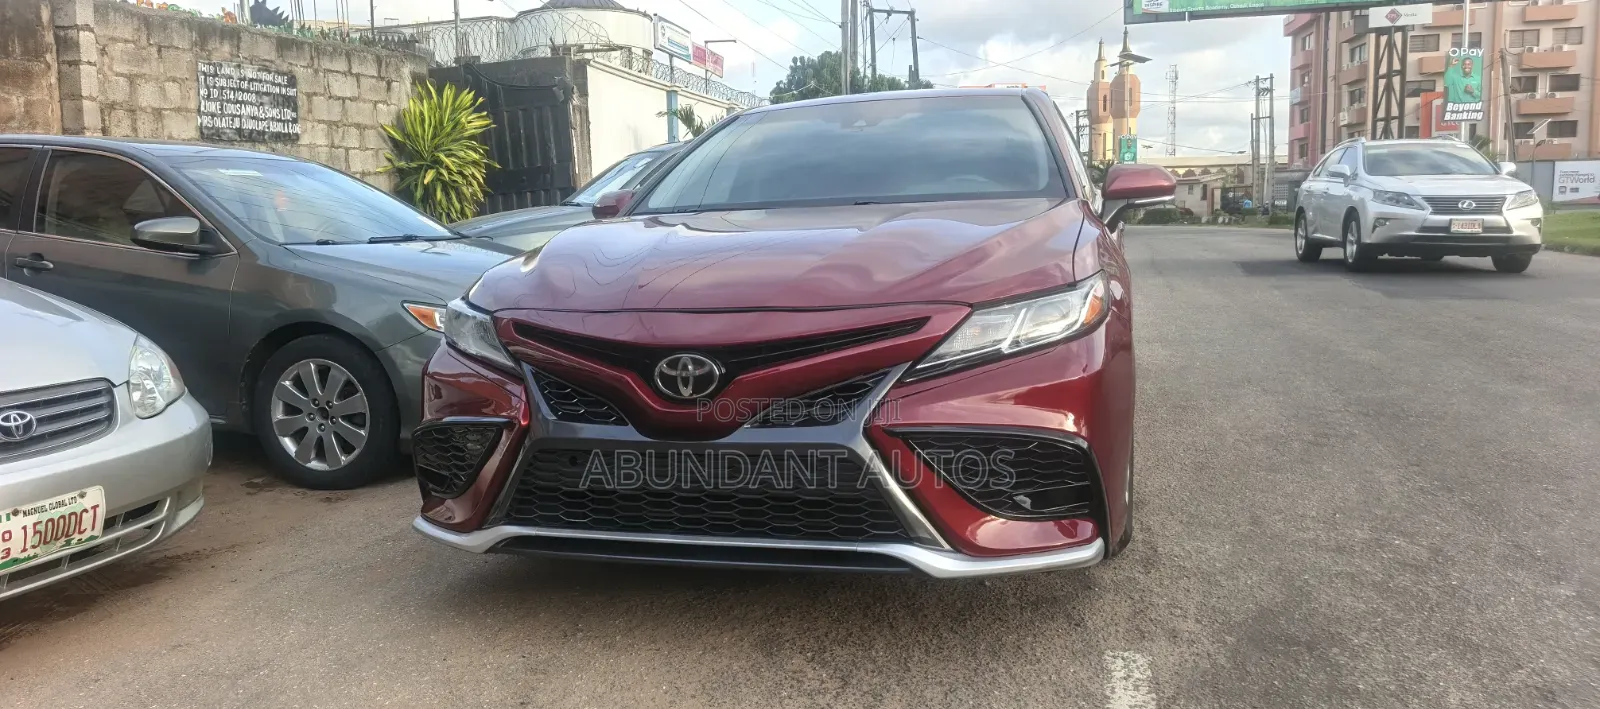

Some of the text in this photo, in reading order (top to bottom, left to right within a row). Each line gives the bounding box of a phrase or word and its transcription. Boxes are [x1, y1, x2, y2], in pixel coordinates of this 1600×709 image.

[1449, 47, 1484, 57] OPay
[216, 66, 235, 75] LAND
[262, 71, 274, 82] FOR
[274, 75, 288, 85] SALE
[214, 77, 240, 88] SUBJECT
[240, 80, 249, 90] OF
[250, 81, 280, 95] LITIGATION
[1446, 101, 1482, 112] Beyond
[1444, 111, 1484, 121] Banking
[1558, 176, 1596, 184] GTWorld
[48, 499, 68, 511] GLOBAL
[68, 496, 78, 505] LTD
